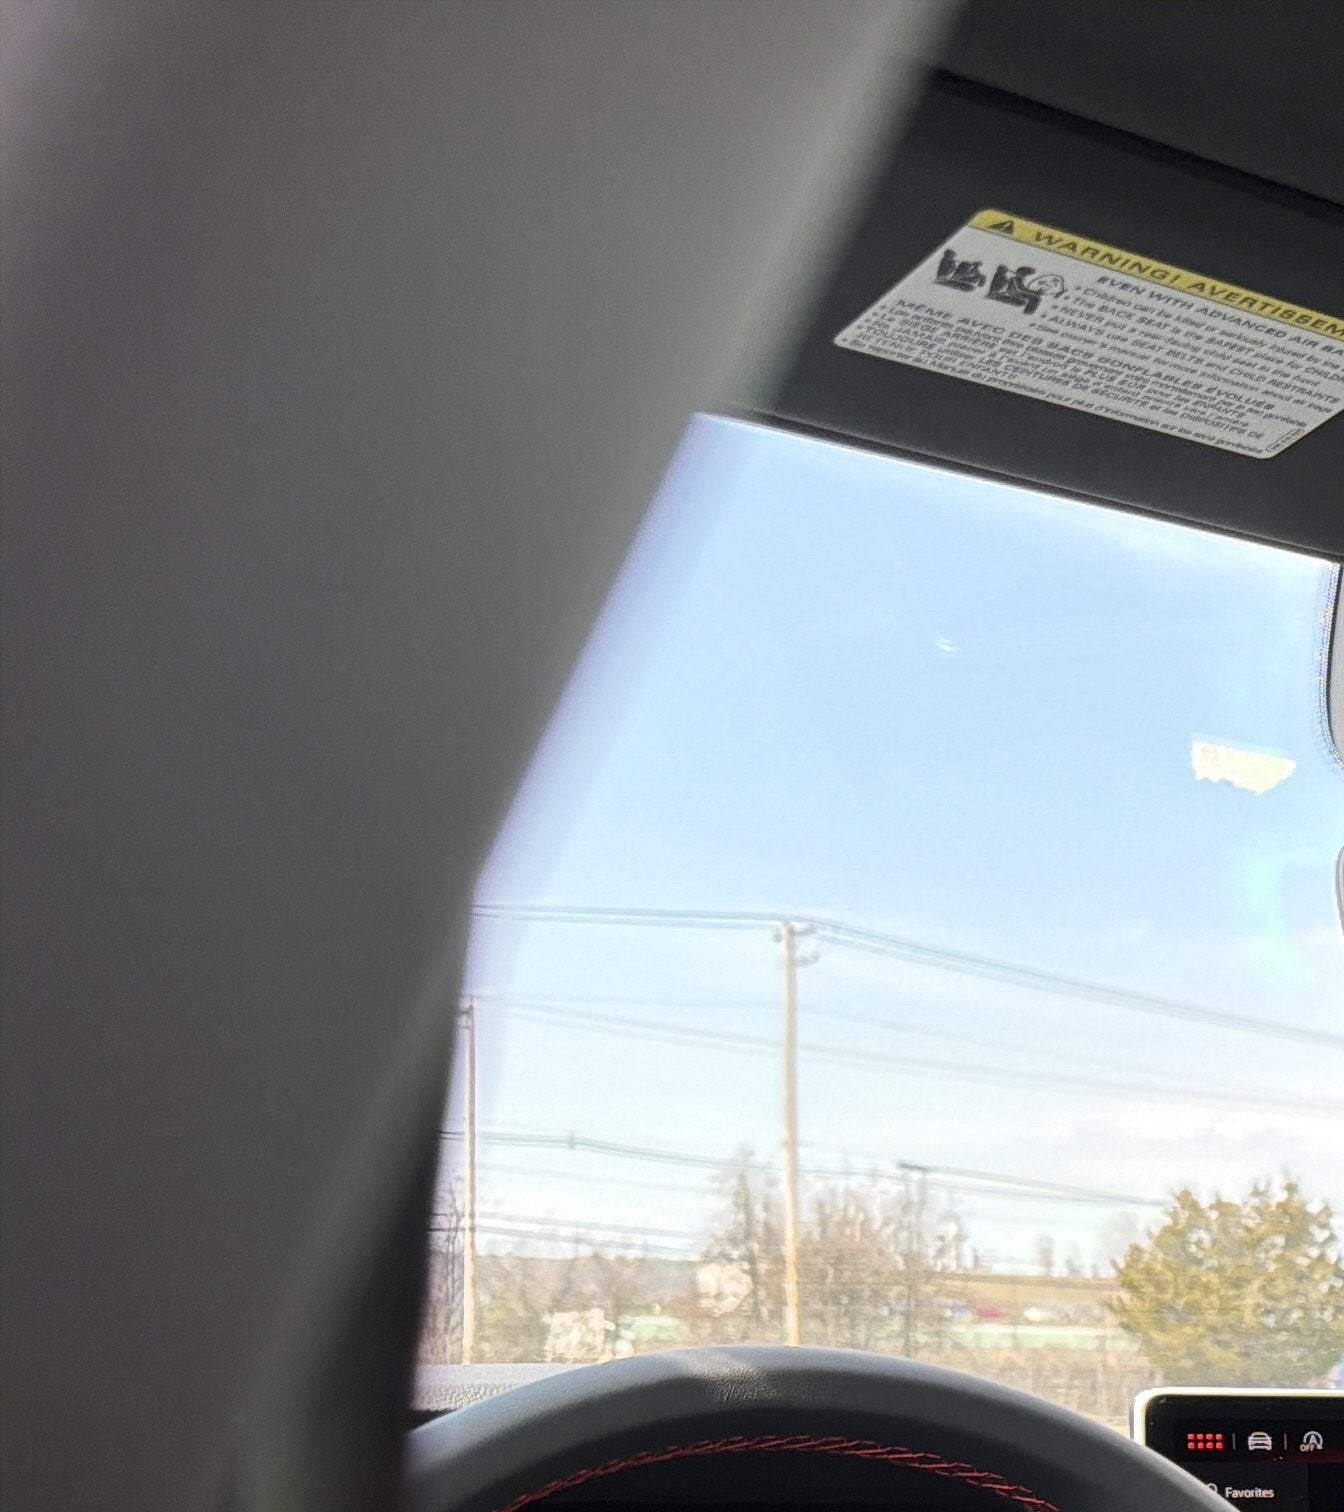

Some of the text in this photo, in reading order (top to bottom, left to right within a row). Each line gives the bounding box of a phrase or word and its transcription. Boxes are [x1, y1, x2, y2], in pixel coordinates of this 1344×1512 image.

[1026, 232, 1182, 284] WARNING!
[1058, 306, 1105, 324] NEVER
[1095, 276, 1146, 295] EVEN
[1144, 291, 1195, 310] WITH
[1193, 306, 1290, 338] ADVANCED
[1286, 334, 1321, 348] AIR
[1095, 305, 1135, 320] BACK
[1135, 316, 1171, 331] SEAT
[1204, 337, 1255, 355] SAFEST
[955, 315, 1008, 335] AVEC
[1044, 340, 1096, 360] SACS
[1095, 355, 1205, 390] GONFLABLES
[1047, 315, 1106, 336] ALWAYS
[1129, 339, 1166, 353] SEAT
[1163, 349, 1205, 365] BELTS
[1265, 379, 1341, 404] RESTRAINTS
[1225, 1486, 1275, 1500] Favorites
